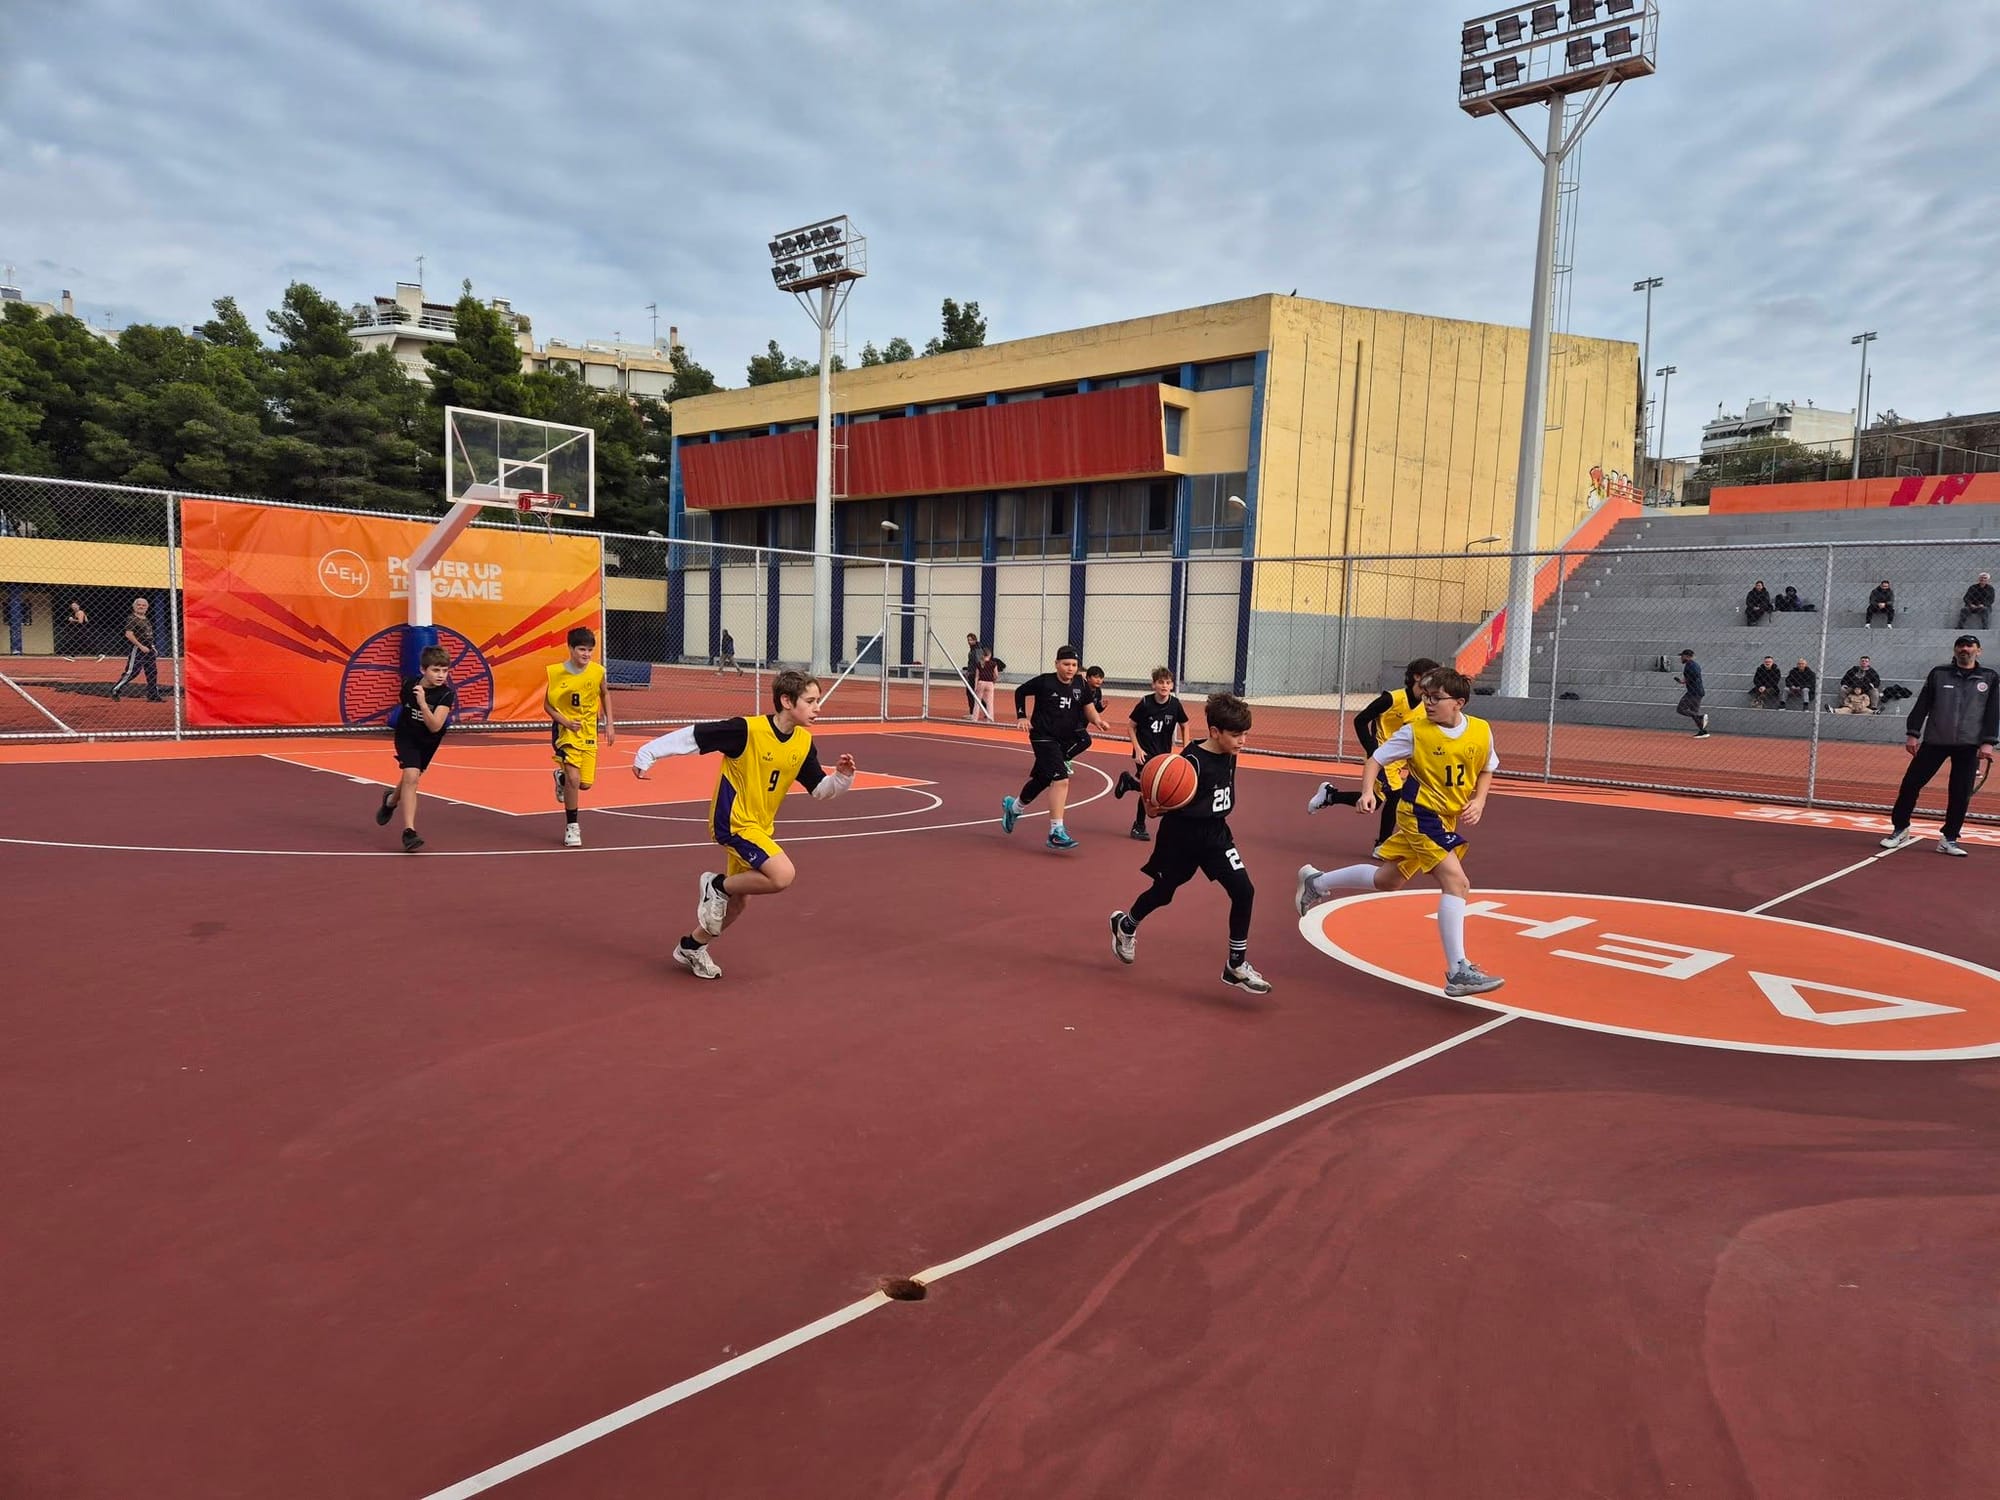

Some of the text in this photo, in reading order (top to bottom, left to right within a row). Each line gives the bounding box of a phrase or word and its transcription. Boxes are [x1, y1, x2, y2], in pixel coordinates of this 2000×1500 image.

[474, 562, 502, 580] UP
[431, 578, 503, 600] GAME
[572, 693, 580, 707] 8
[1059, 697, 1071, 709] 34
[1150, 720, 1163, 733] 41
[768, 770, 780, 791] 9
[1445, 764, 1465, 787] 12
[1212, 786, 1231, 812] 28
